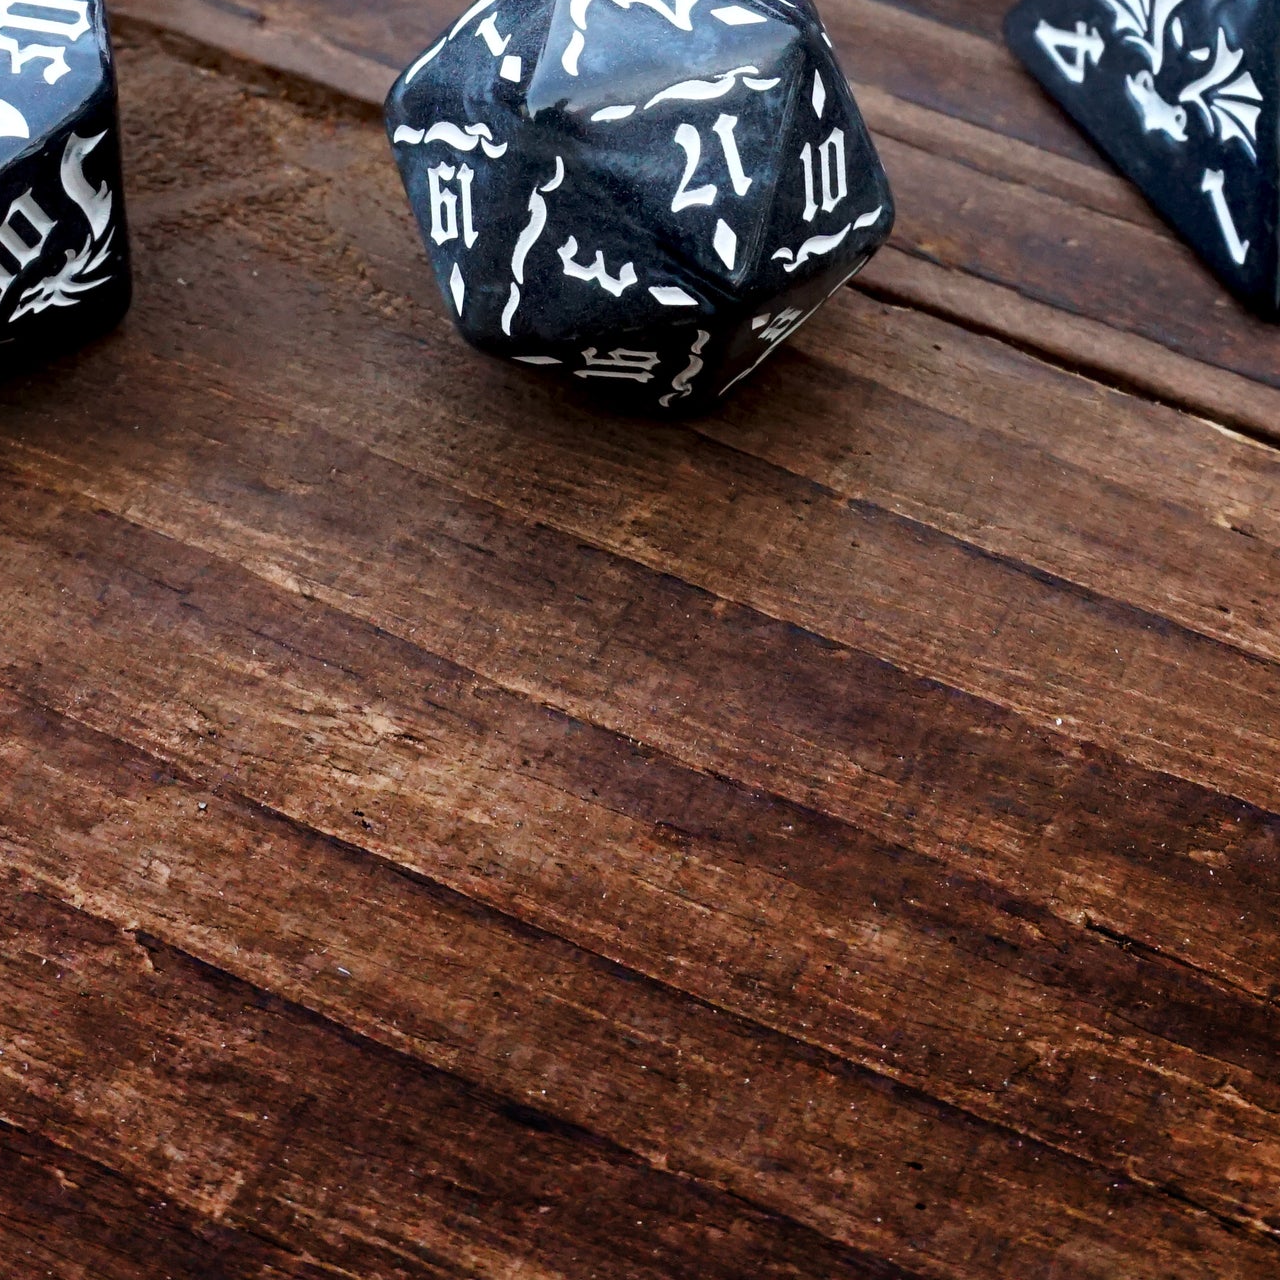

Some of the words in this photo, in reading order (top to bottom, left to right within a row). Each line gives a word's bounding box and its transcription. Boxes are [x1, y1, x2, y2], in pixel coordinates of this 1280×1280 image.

[1034, 19, 1105, 84] 4
[799, 126, 847, 222] 10
[1200, 167, 1250, 265] 1
[557, 235, 638, 297] 3
